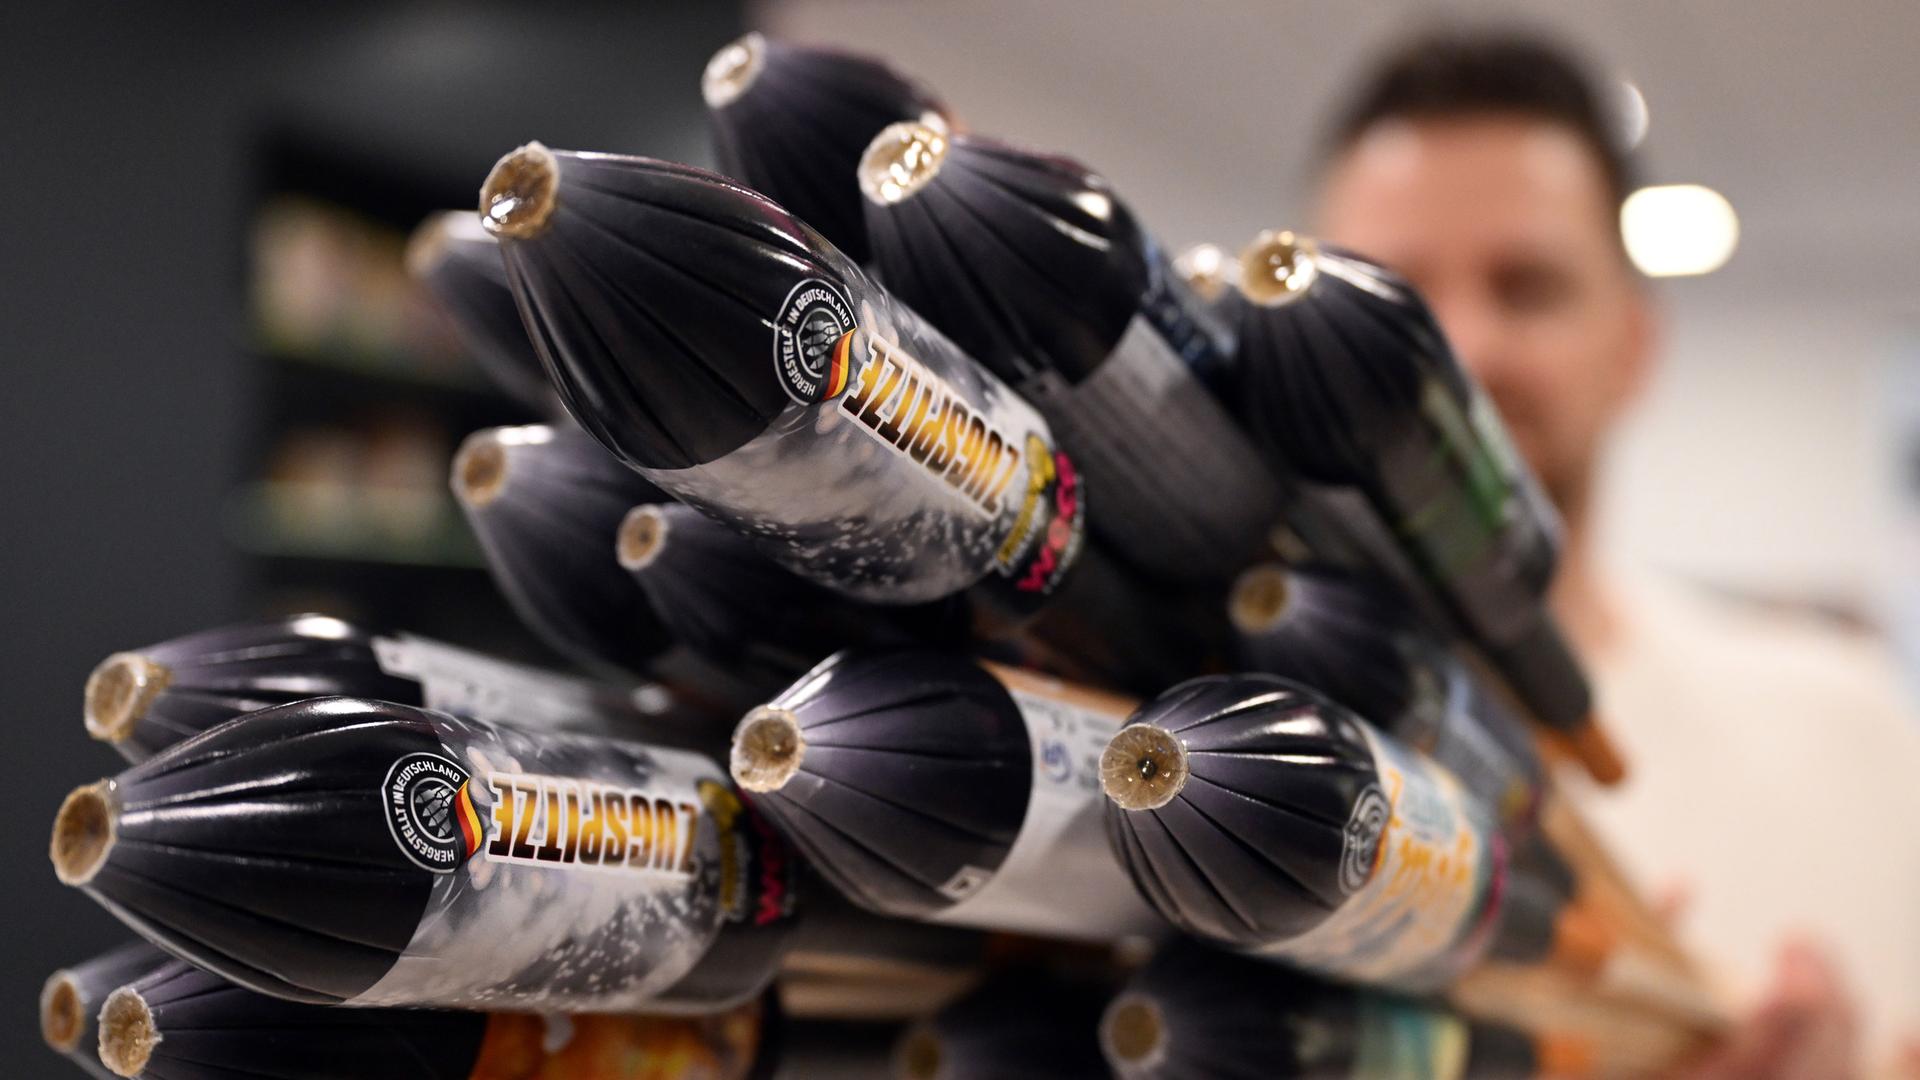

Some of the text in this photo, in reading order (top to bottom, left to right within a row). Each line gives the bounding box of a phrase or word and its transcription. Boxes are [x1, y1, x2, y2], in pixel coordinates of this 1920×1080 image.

[787, 309, 800, 325] IN
[795, 288, 851, 328] DEUTSCHLAND
[840, 336, 1020, 517] ZUGSPITZE
[392, 760, 461, 862] HERGESTELLT IN DEUTSCHLAND
[487, 774, 697, 875] ZUGSPITZE
